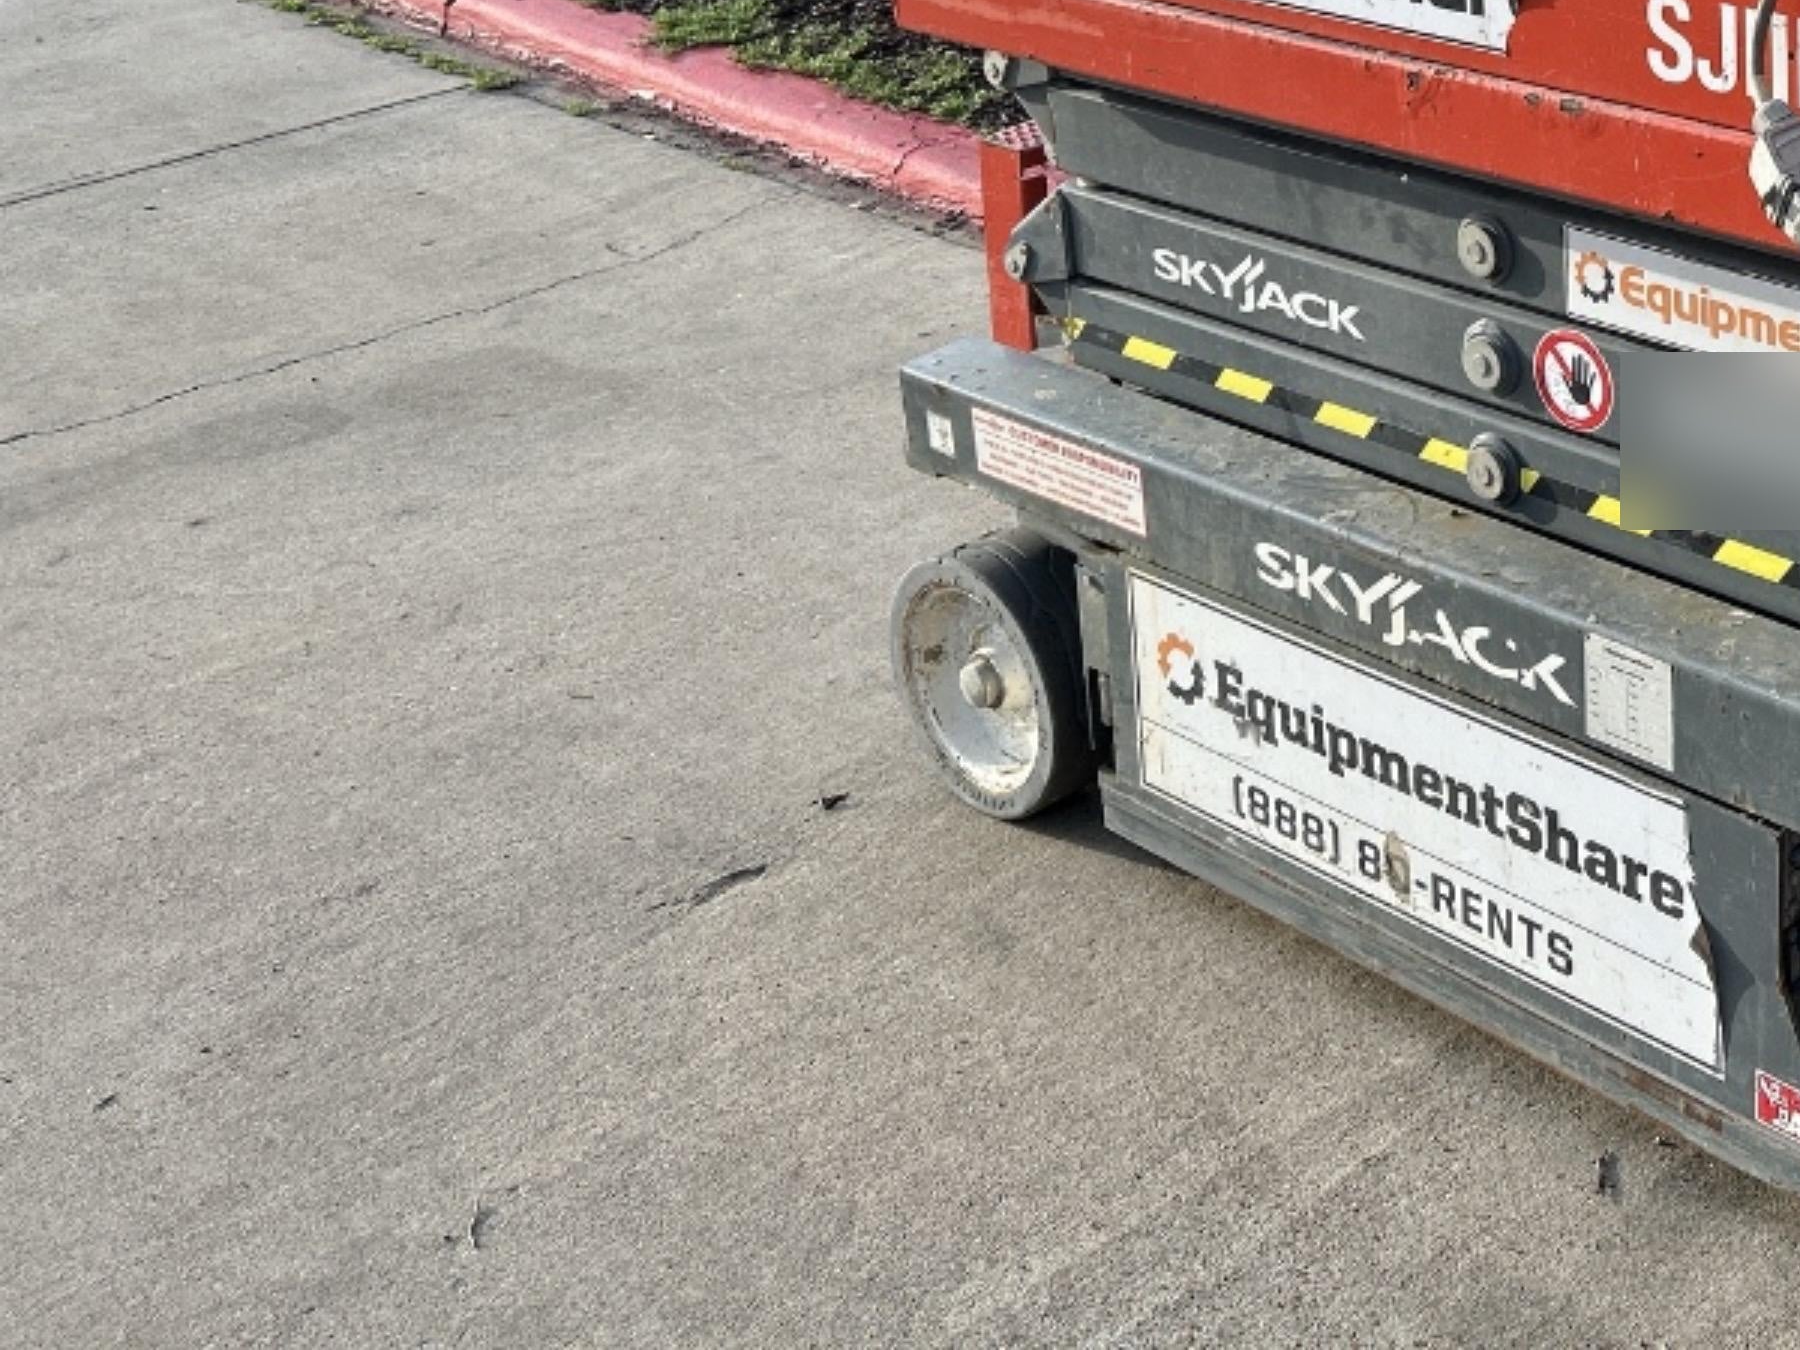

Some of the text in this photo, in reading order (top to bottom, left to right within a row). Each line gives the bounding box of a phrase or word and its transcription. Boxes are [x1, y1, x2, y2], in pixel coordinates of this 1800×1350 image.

[1151, 247, 1366, 341] SKYJACK
[1253, 540, 1580, 709] SKYJACK
[1211, 659, 1686, 919] EquipmentShare
[1232, 774, 1341, 865] (888)
